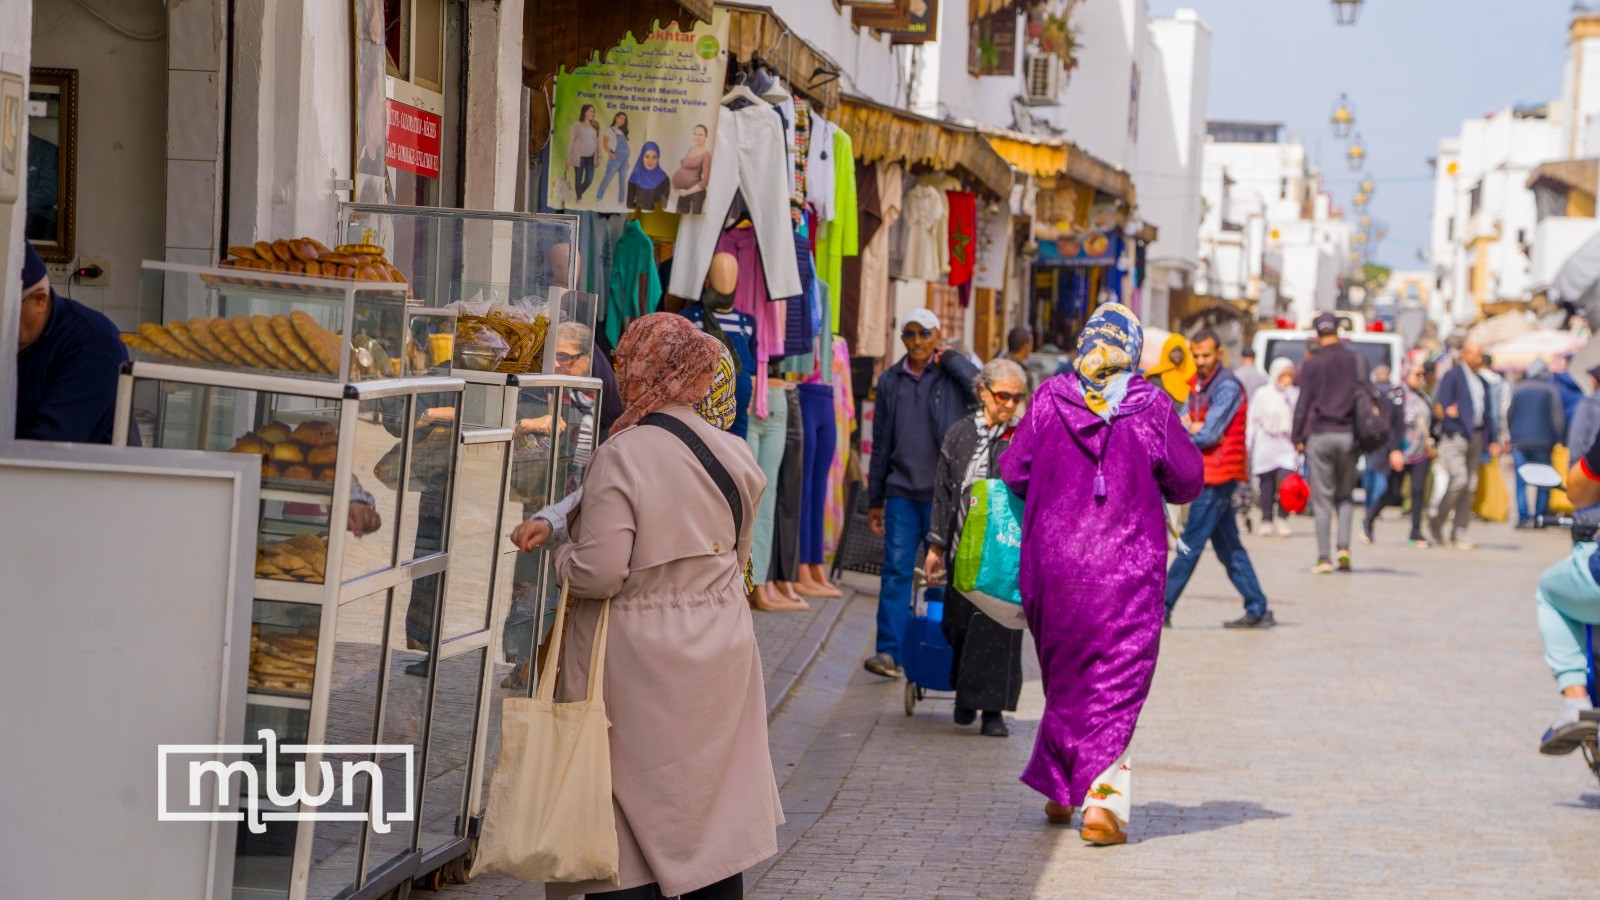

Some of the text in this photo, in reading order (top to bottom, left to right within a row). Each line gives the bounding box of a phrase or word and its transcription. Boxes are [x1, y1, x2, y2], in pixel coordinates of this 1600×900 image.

[648, 29, 696, 42] okhtar
[619, 85, 645, 94] Porter
[659, 87, 688, 96] Maillot
[577, 91, 596, 99] Pour
[598, 93, 629, 101] Femme
[631, 95, 668, 104] Enceinte
[606, 102, 618, 110] En
[619, 103, 640, 112] Gros
